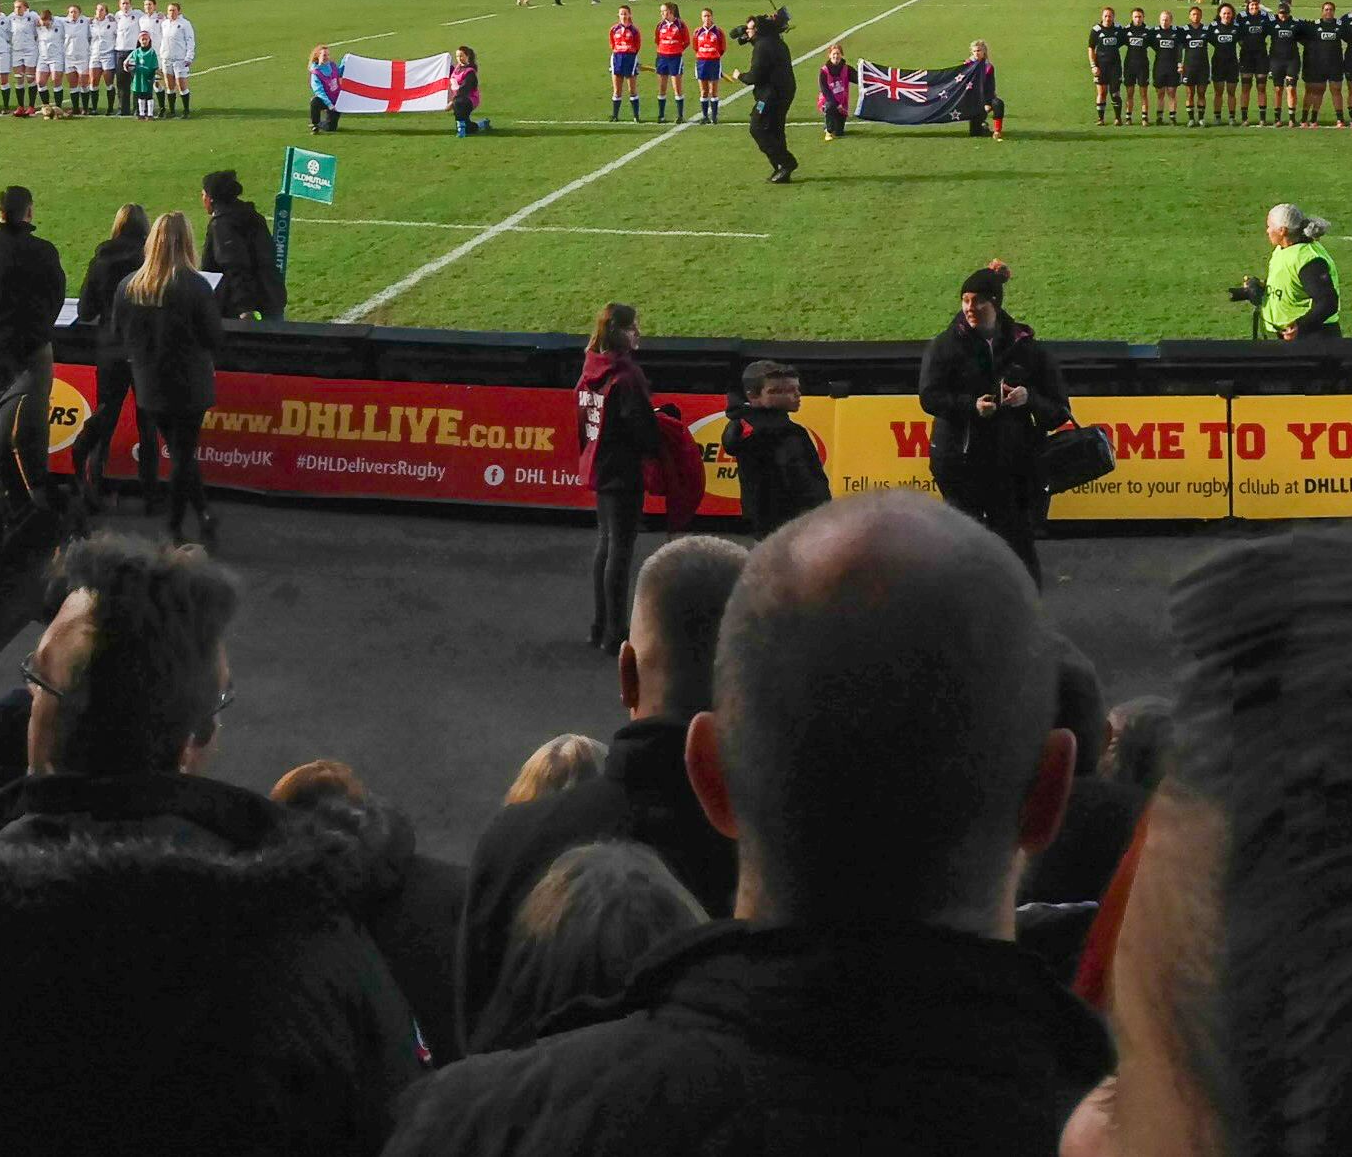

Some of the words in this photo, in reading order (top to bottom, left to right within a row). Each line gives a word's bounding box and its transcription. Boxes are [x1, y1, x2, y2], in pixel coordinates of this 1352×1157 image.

[293, 172, 331, 187] OLDMUTUAL
[1199, 422, 1266, 460] TO
[296, 453, 446, 482] #DHLDeliversRugby
[515, 468, 546, 485] DHL
[843, 475, 867, 492] Tell
[875, 480, 888, 493] us
[1127, 480, 1142, 494] to
[1147, 481, 1180, 498] your
[1187, 477, 1230, 498] rugby
[1285, 482, 1299, 495] at
